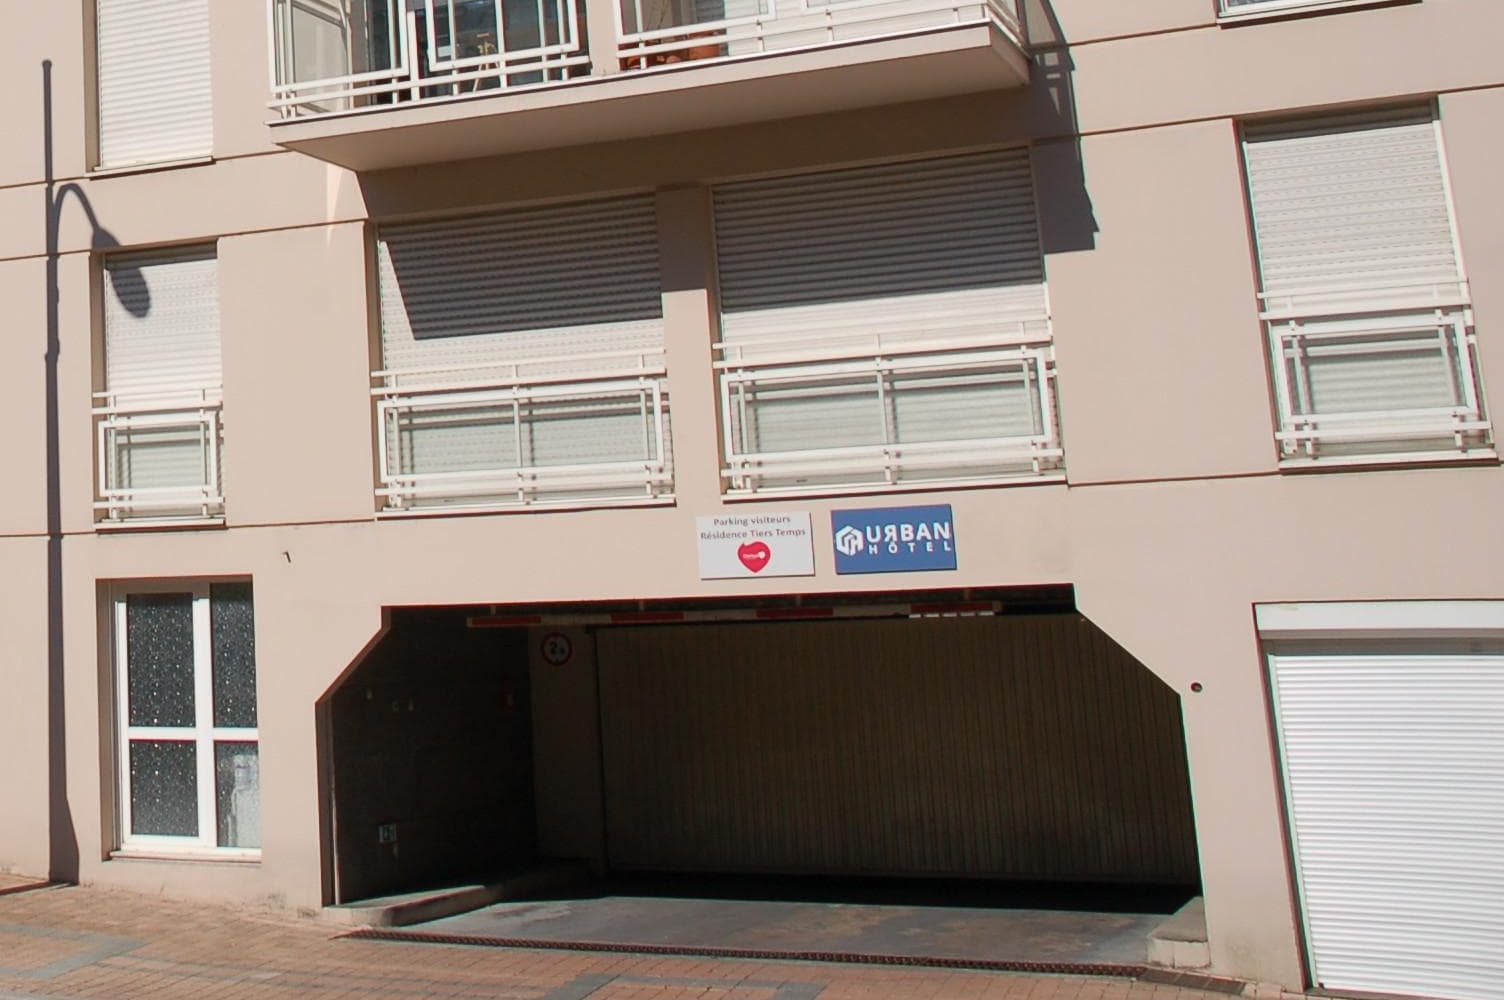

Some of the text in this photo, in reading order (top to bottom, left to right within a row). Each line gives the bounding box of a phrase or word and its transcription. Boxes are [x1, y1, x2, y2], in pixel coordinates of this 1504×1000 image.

[713, 514, 791, 527] Parking visiteurs
[700, 527, 807, 540] Résidence Tiers Temps
[865, 521, 950, 543] URBAN
